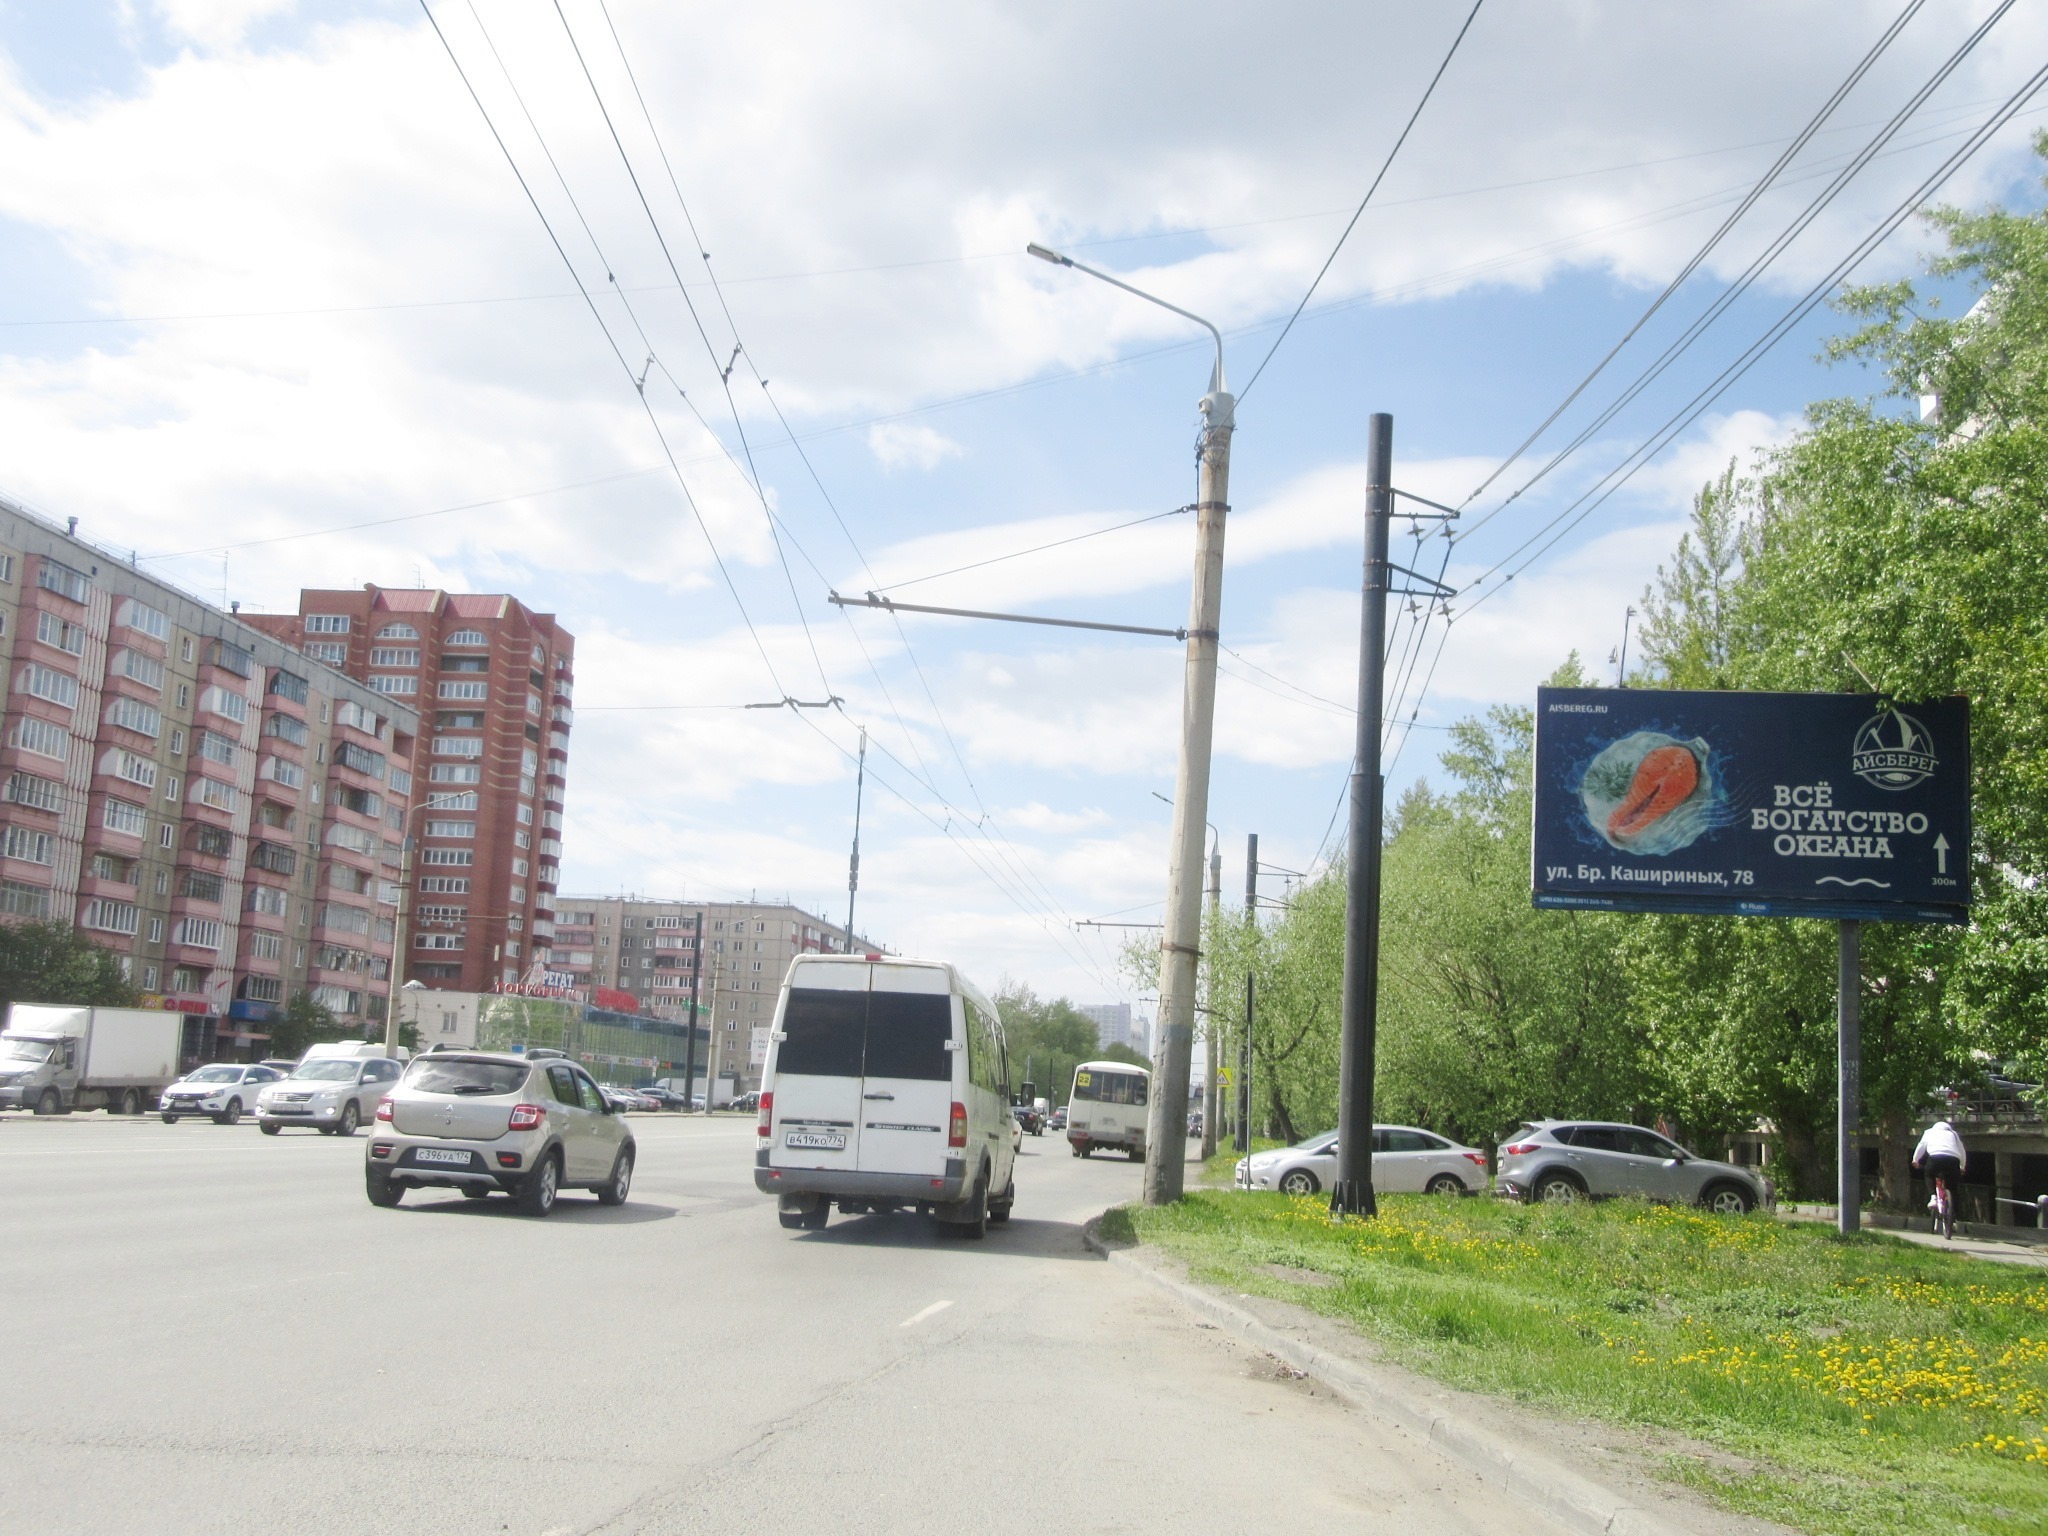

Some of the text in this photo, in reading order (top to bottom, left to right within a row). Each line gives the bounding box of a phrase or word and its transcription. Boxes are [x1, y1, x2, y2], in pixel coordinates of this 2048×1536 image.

[1549, 703, 1608, 714] AISBEREG.RU
[1853, 752, 1939, 771] АЙСБЕРЕГ
[1774, 781, 1832, 807] ВСЁ
[1751, 809, 1928, 834] БОГАТСТВО
[1774, 835, 1894, 858] ОКЕАНА
[1546, 865, 1754, 886] ул. Бр. Кашириных, 78
[1932, 877, 1957, 886] 300м
